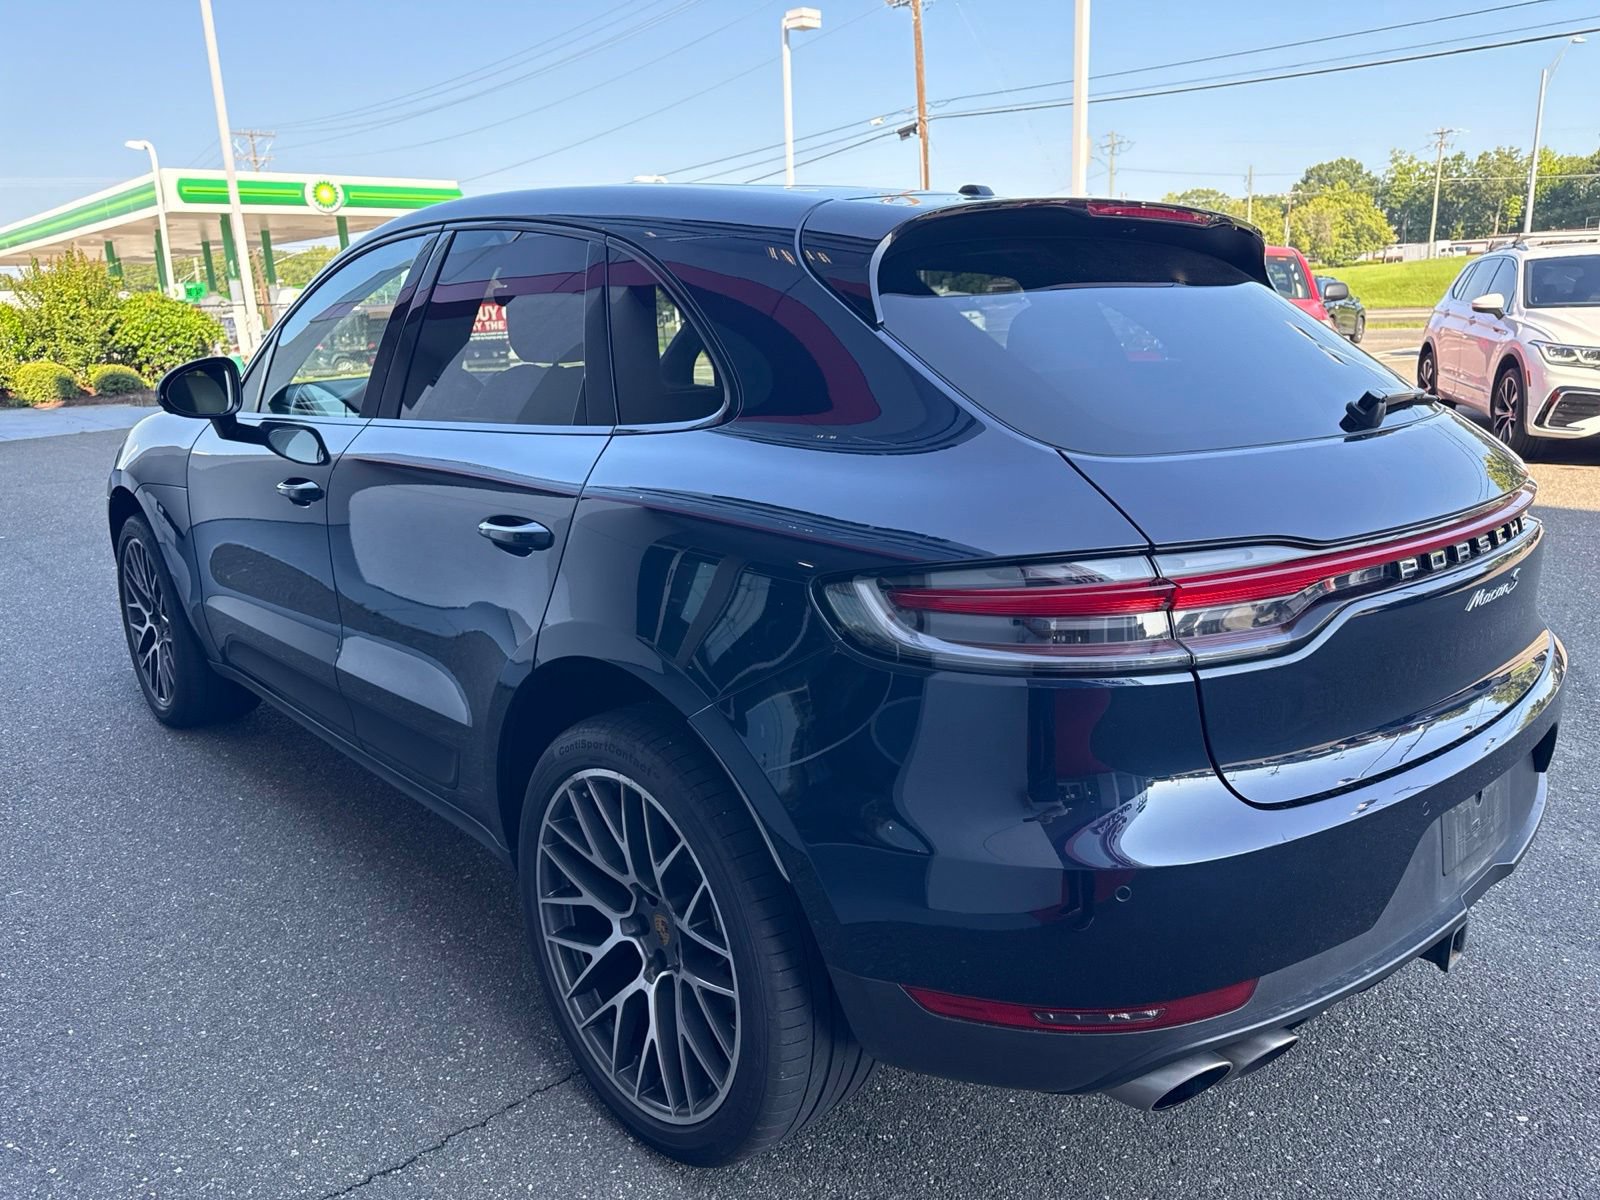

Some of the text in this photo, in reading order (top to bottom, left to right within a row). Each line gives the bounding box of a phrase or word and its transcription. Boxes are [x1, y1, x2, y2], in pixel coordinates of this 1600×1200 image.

[475, 305, 499, 321] UY
[484, 320, 506, 331] THE
[1399, 510, 1529, 579] PORSCHE
[1464, 567, 1521, 612] Macan S
[558, 739, 654, 777] ContiSportContact
